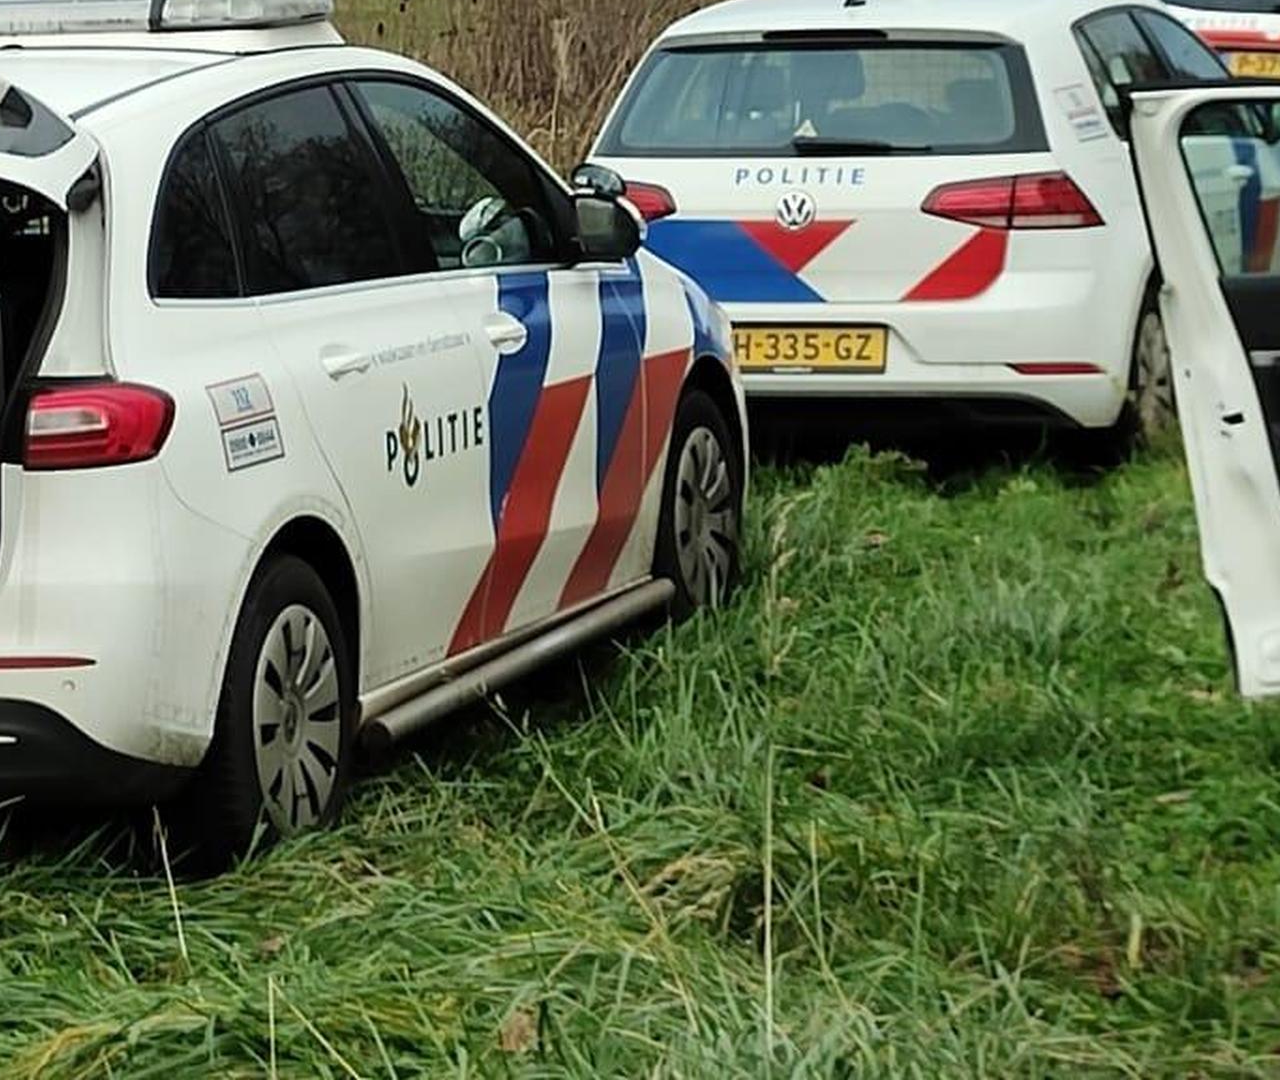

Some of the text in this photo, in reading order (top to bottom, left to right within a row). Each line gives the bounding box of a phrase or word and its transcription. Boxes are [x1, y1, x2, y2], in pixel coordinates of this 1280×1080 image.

[735, 167, 866, 186] POLITIE
[734, 332, 873, 362] H-335-GZ
[386, 404, 483, 488] POLITIE
